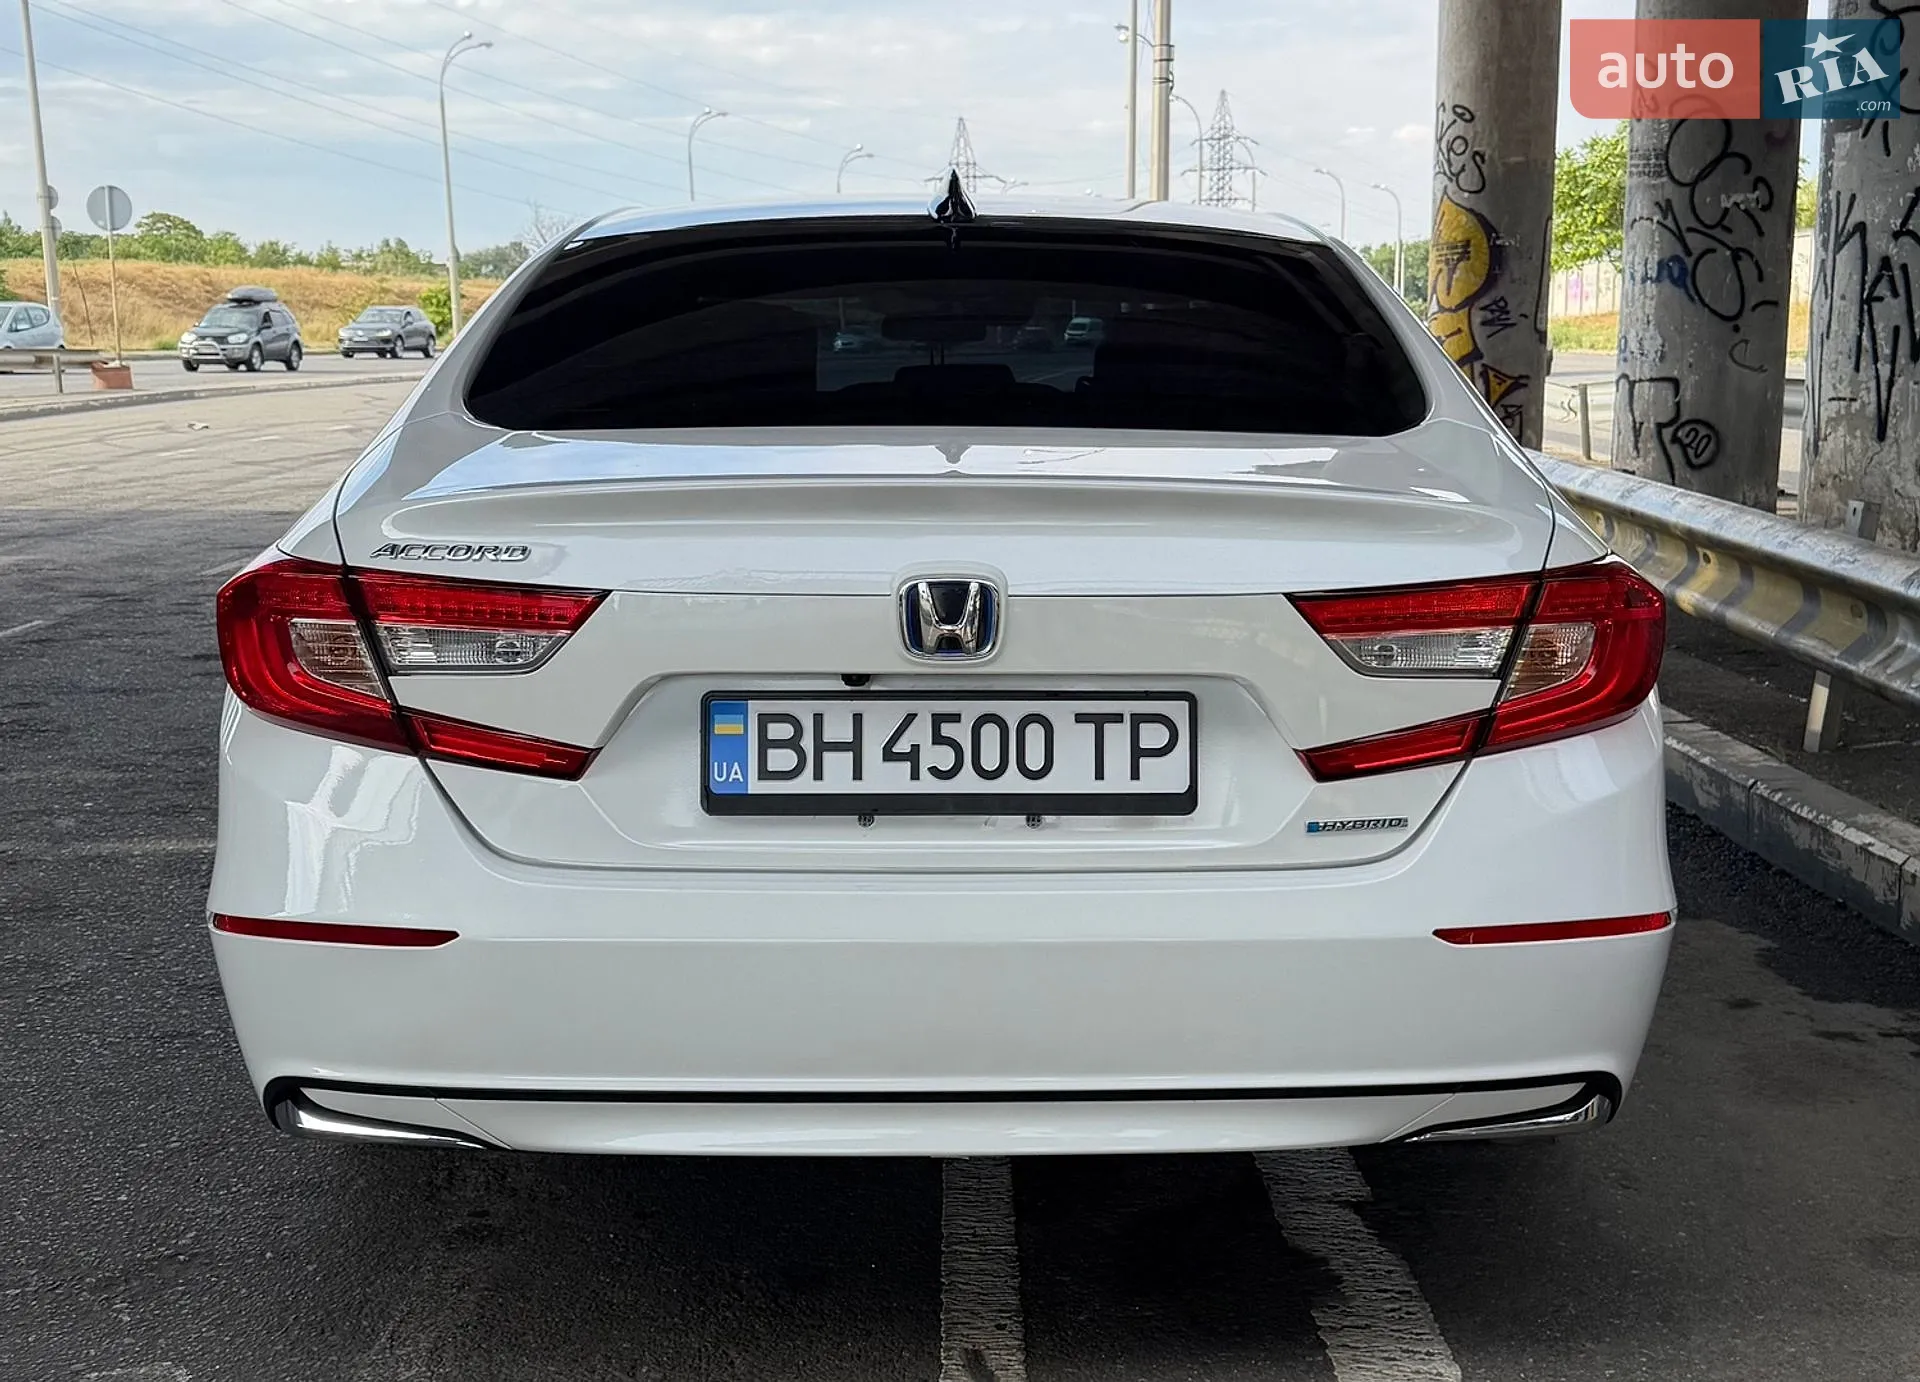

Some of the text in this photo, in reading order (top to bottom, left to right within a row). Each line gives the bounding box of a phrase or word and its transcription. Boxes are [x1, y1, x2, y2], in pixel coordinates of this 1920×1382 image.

[370, 542, 532, 562] ACCORD
[757, 713, 1180, 781] BH 4500 TP
[713, 762, 744, 783] UA
[1319, 817, 1402, 832] HYBRID
